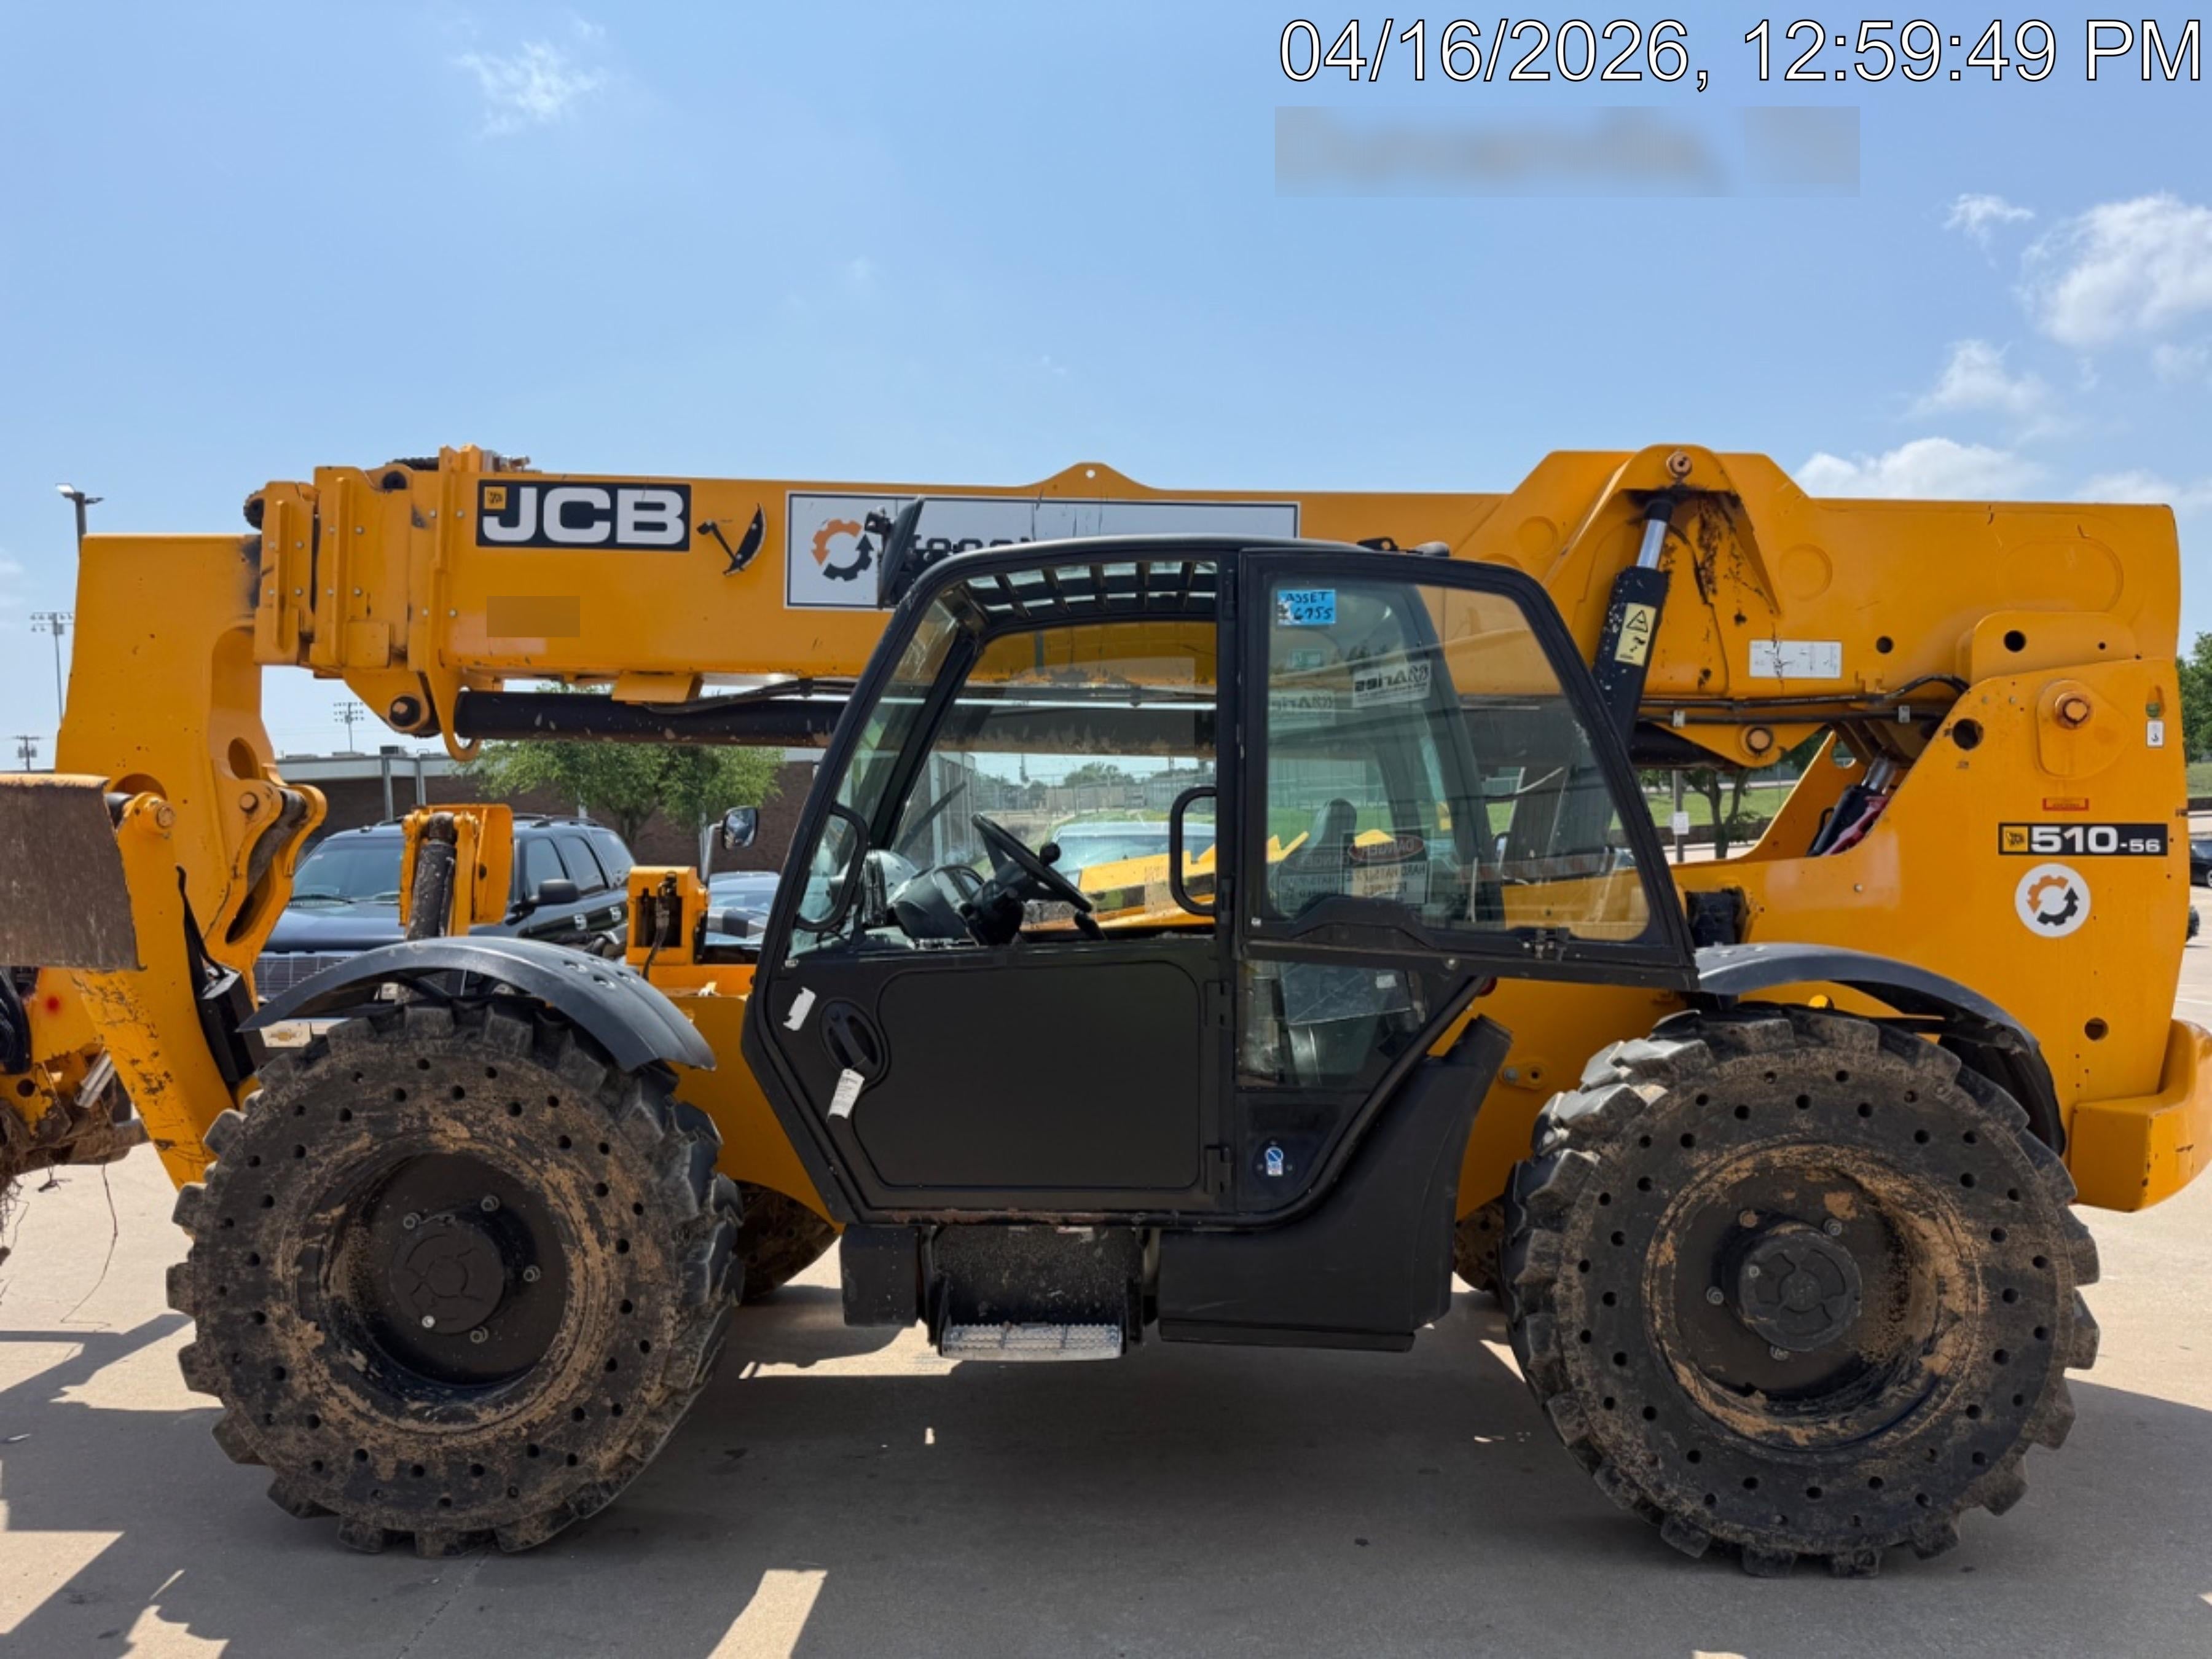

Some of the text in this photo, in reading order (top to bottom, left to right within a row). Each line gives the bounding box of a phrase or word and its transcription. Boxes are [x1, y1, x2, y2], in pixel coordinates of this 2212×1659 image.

[482, 486, 685, 545] JCB
[1286, 592, 1333, 603] ASSET
[2031, 826, 2161, 853] 510-56
